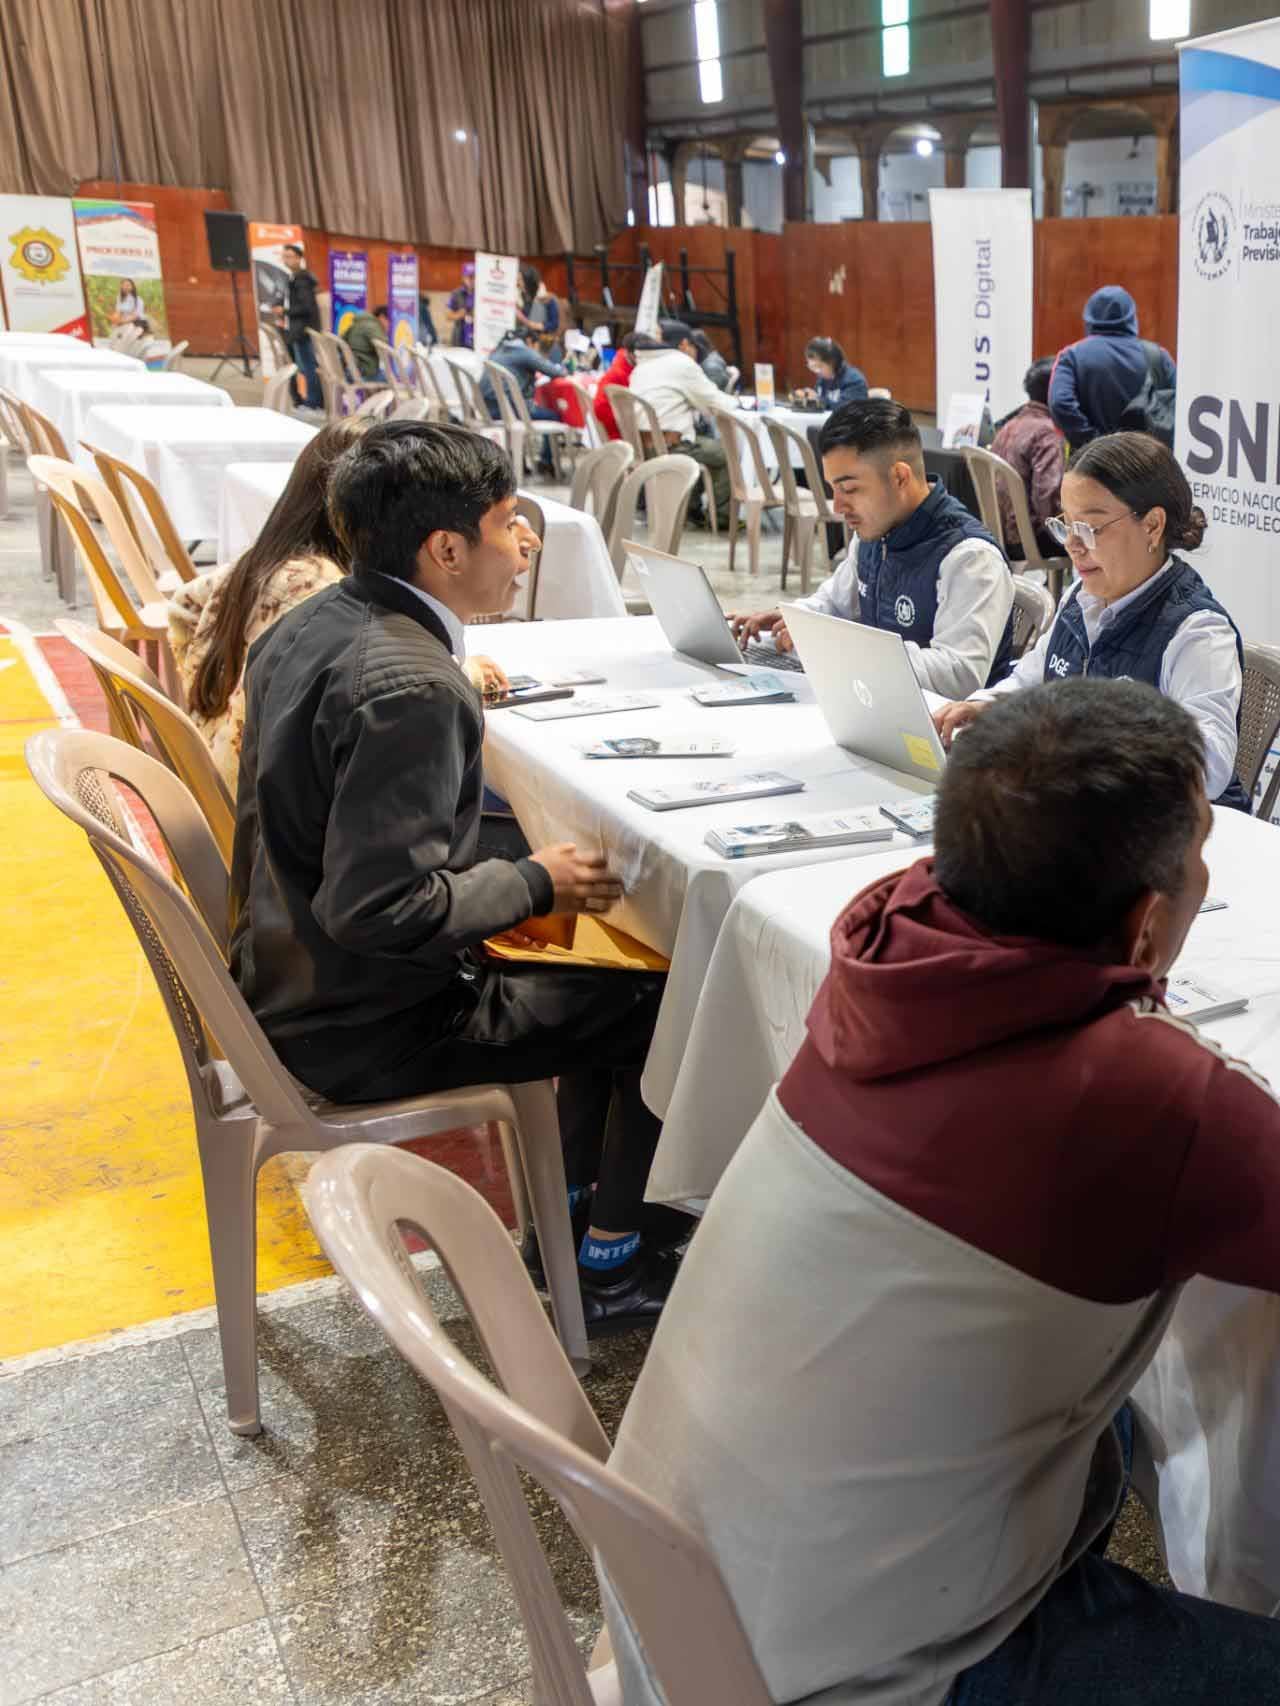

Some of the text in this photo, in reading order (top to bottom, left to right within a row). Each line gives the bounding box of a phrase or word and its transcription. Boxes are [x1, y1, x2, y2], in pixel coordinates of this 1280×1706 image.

[975, 239, 995, 319] Digital
[1188, 481, 1240, 505] ERVICIO
[1212, 505, 1229, 523] DE
[1049, 653, 1071, 677] DGE
